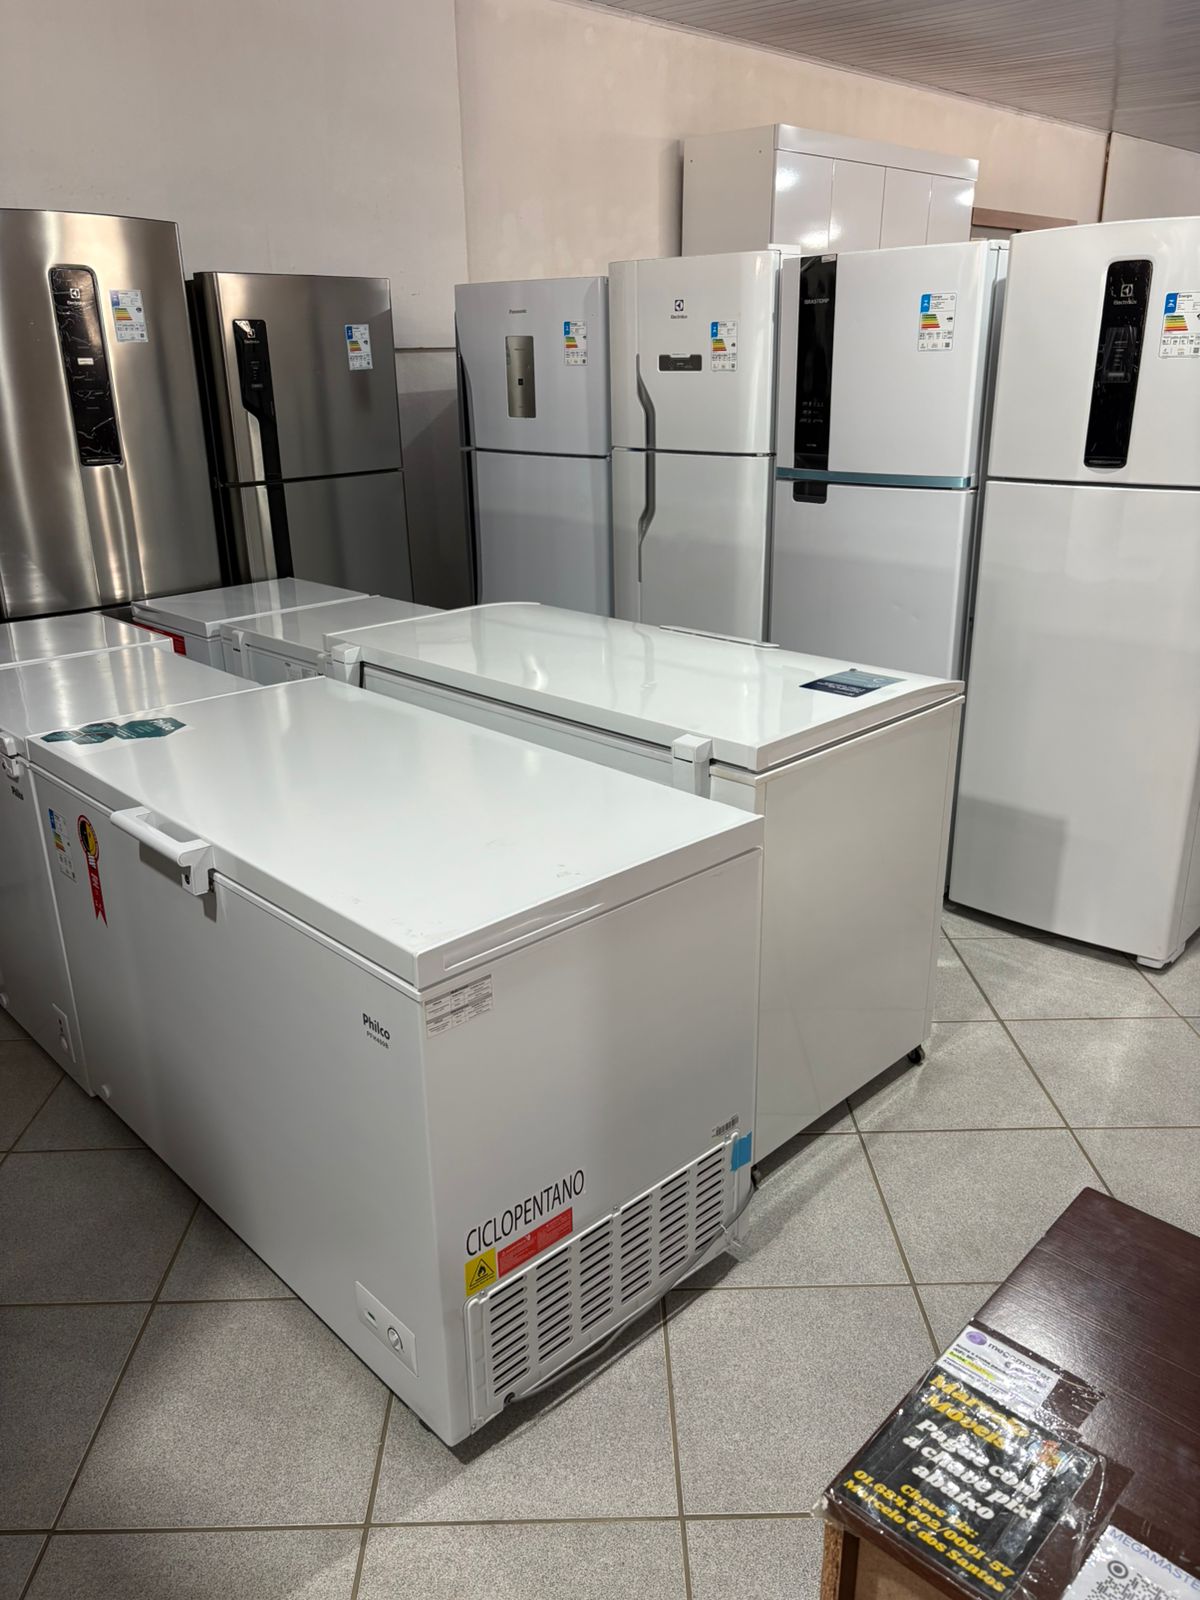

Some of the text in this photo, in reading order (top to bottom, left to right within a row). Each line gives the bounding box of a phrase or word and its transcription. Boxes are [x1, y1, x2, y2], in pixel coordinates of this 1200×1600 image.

[362, 1012, 391, 1041] Philco
[466, 1169, 585, 1256] CICLOPENTANO
[915, 1419, 1042, 1501] Pague com
[926, 1394, 1007, 1450] Móveis
[900, 1484, 947, 1518] Chave
[902, 1435, 1032, 1519] a chave pix
[911, 1465, 995, 1520] abaixo
[843, 1479, 1006, 1593] Marcelo C dos Santos
[853, 1470, 1015, 1578] 01.684.902/0001-57
